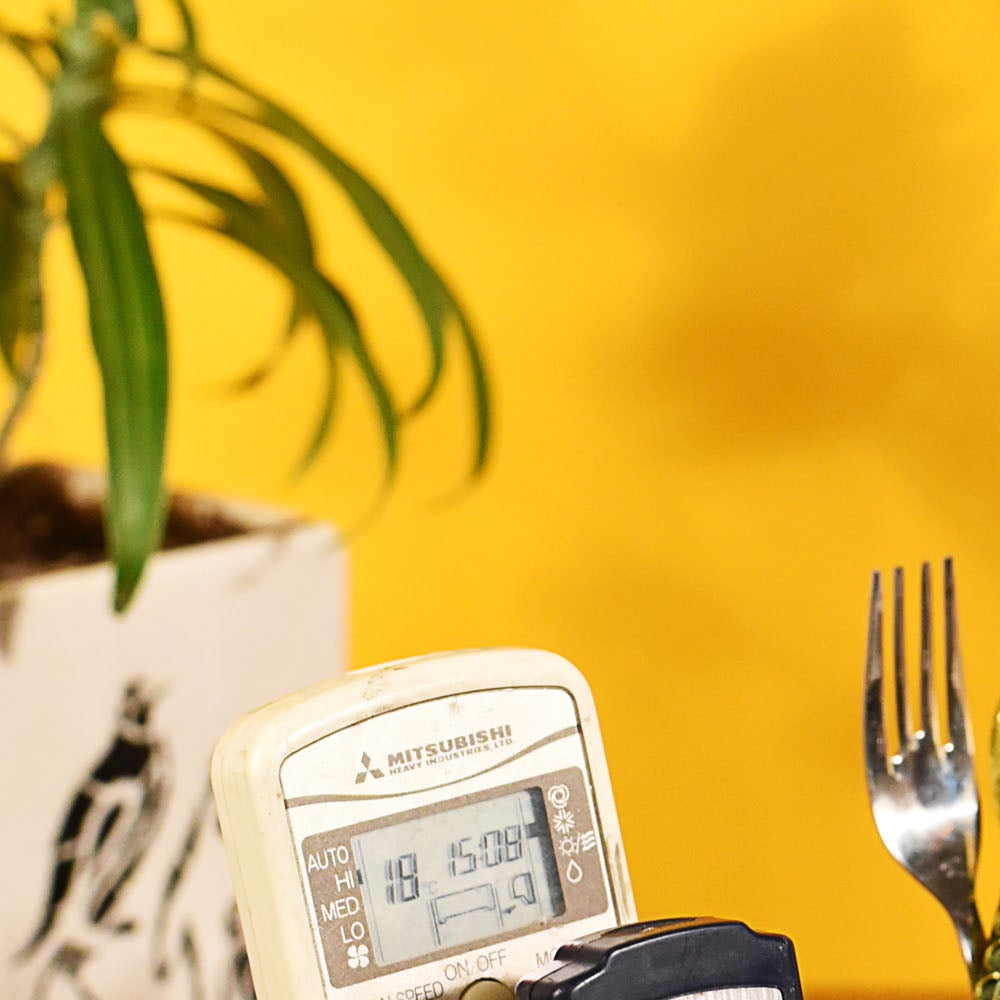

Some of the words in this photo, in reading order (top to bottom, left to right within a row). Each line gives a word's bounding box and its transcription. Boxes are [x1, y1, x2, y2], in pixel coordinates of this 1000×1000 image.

[387, 724, 512, 768] MITSUBISHI
[389, 762, 422, 776] HEAVY
[307, 845, 349, 873] AUTO
[334, 870, 355, 893] HI
[321, 896, 360, 922] MED
[340, 921, 365, 944] LO
